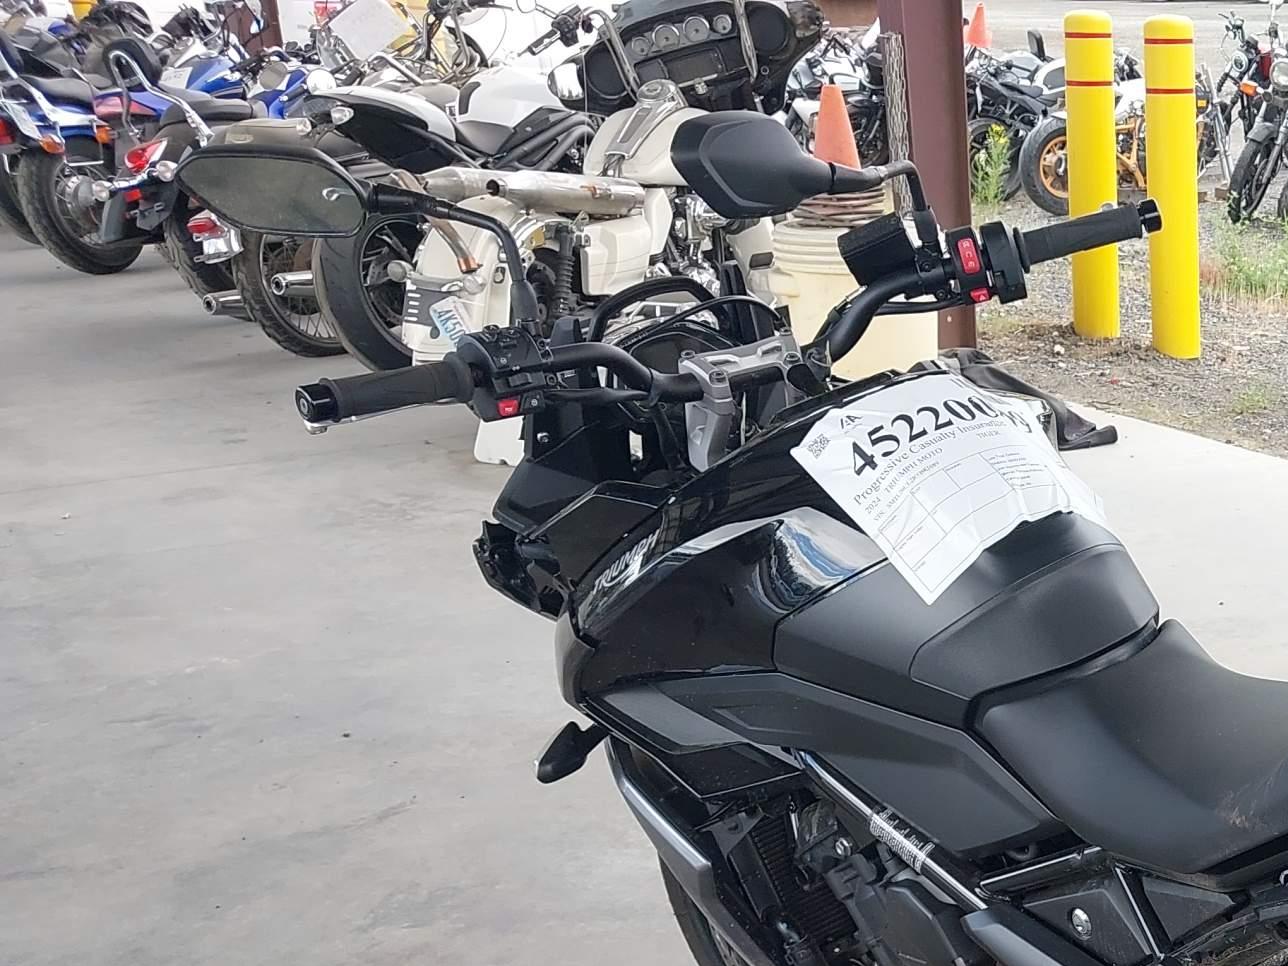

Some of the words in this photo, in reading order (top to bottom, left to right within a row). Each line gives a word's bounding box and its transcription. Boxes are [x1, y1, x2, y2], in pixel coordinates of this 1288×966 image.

[853, 451, 909, 505] Progressive
[909, 428, 956, 454] Casualty
[865, 496, 881, 514] 2024
[884, 461, 918, 494] TRIUMPH
[916, 447, 943, 471] MOTO
[593, 527, 661, 595] TRIUMPH
